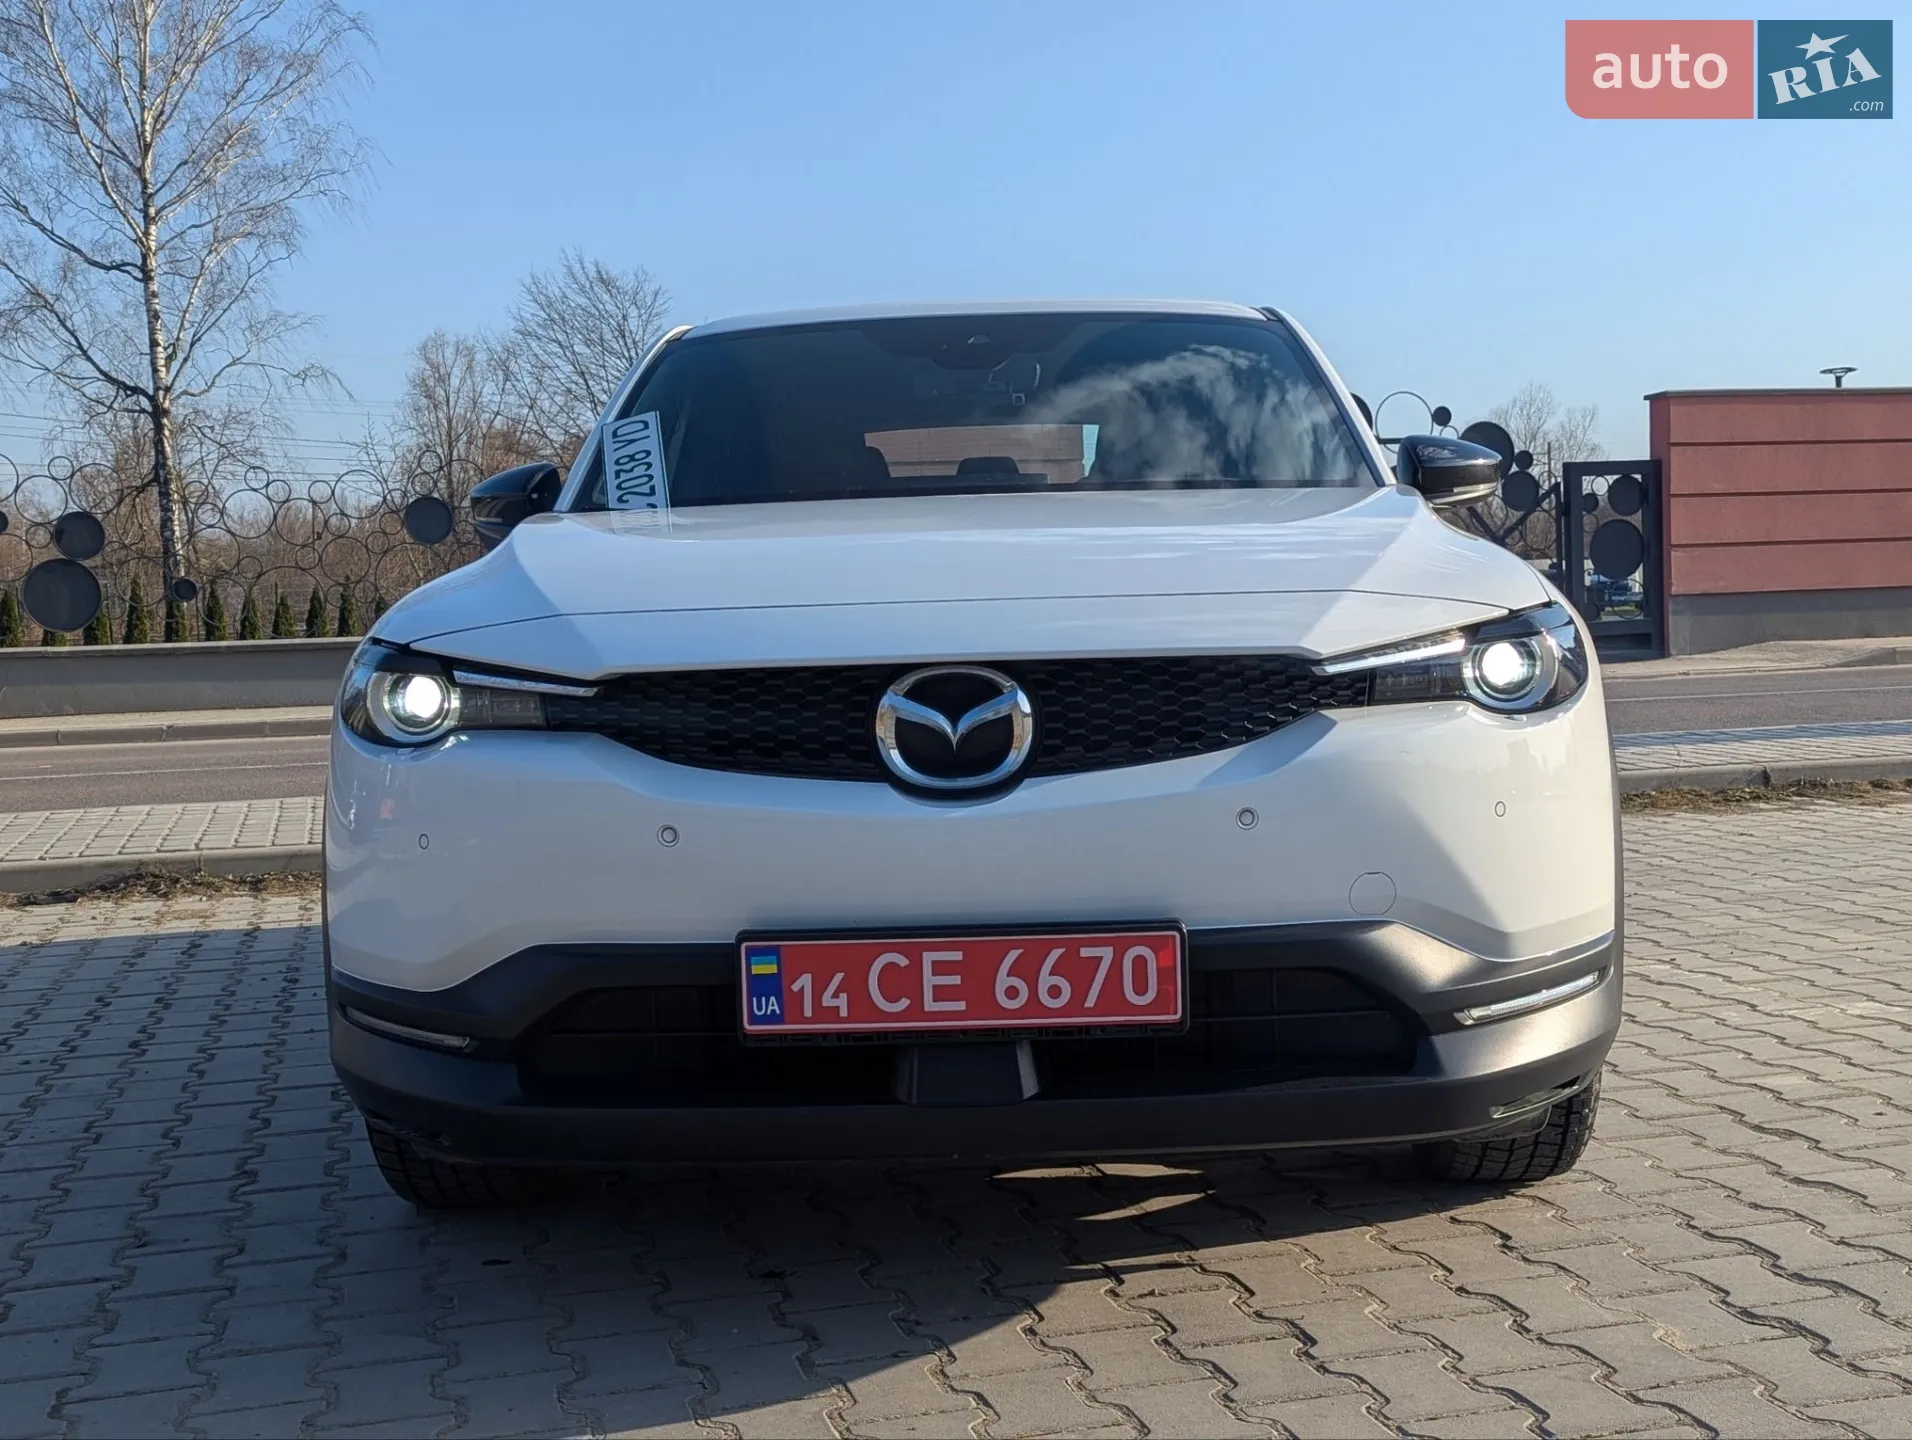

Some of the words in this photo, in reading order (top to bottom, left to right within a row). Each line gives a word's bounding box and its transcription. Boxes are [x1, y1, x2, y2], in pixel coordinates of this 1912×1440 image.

[611, 419, 651, 453] YD
[614, 449, 657, 504] 2038
[790, 972, 848, 1018] 14
[867, 950, 967, 1013] CE
[993, 945, 1159, 1010] 6670
[752, 995, 780, 1016] UA
